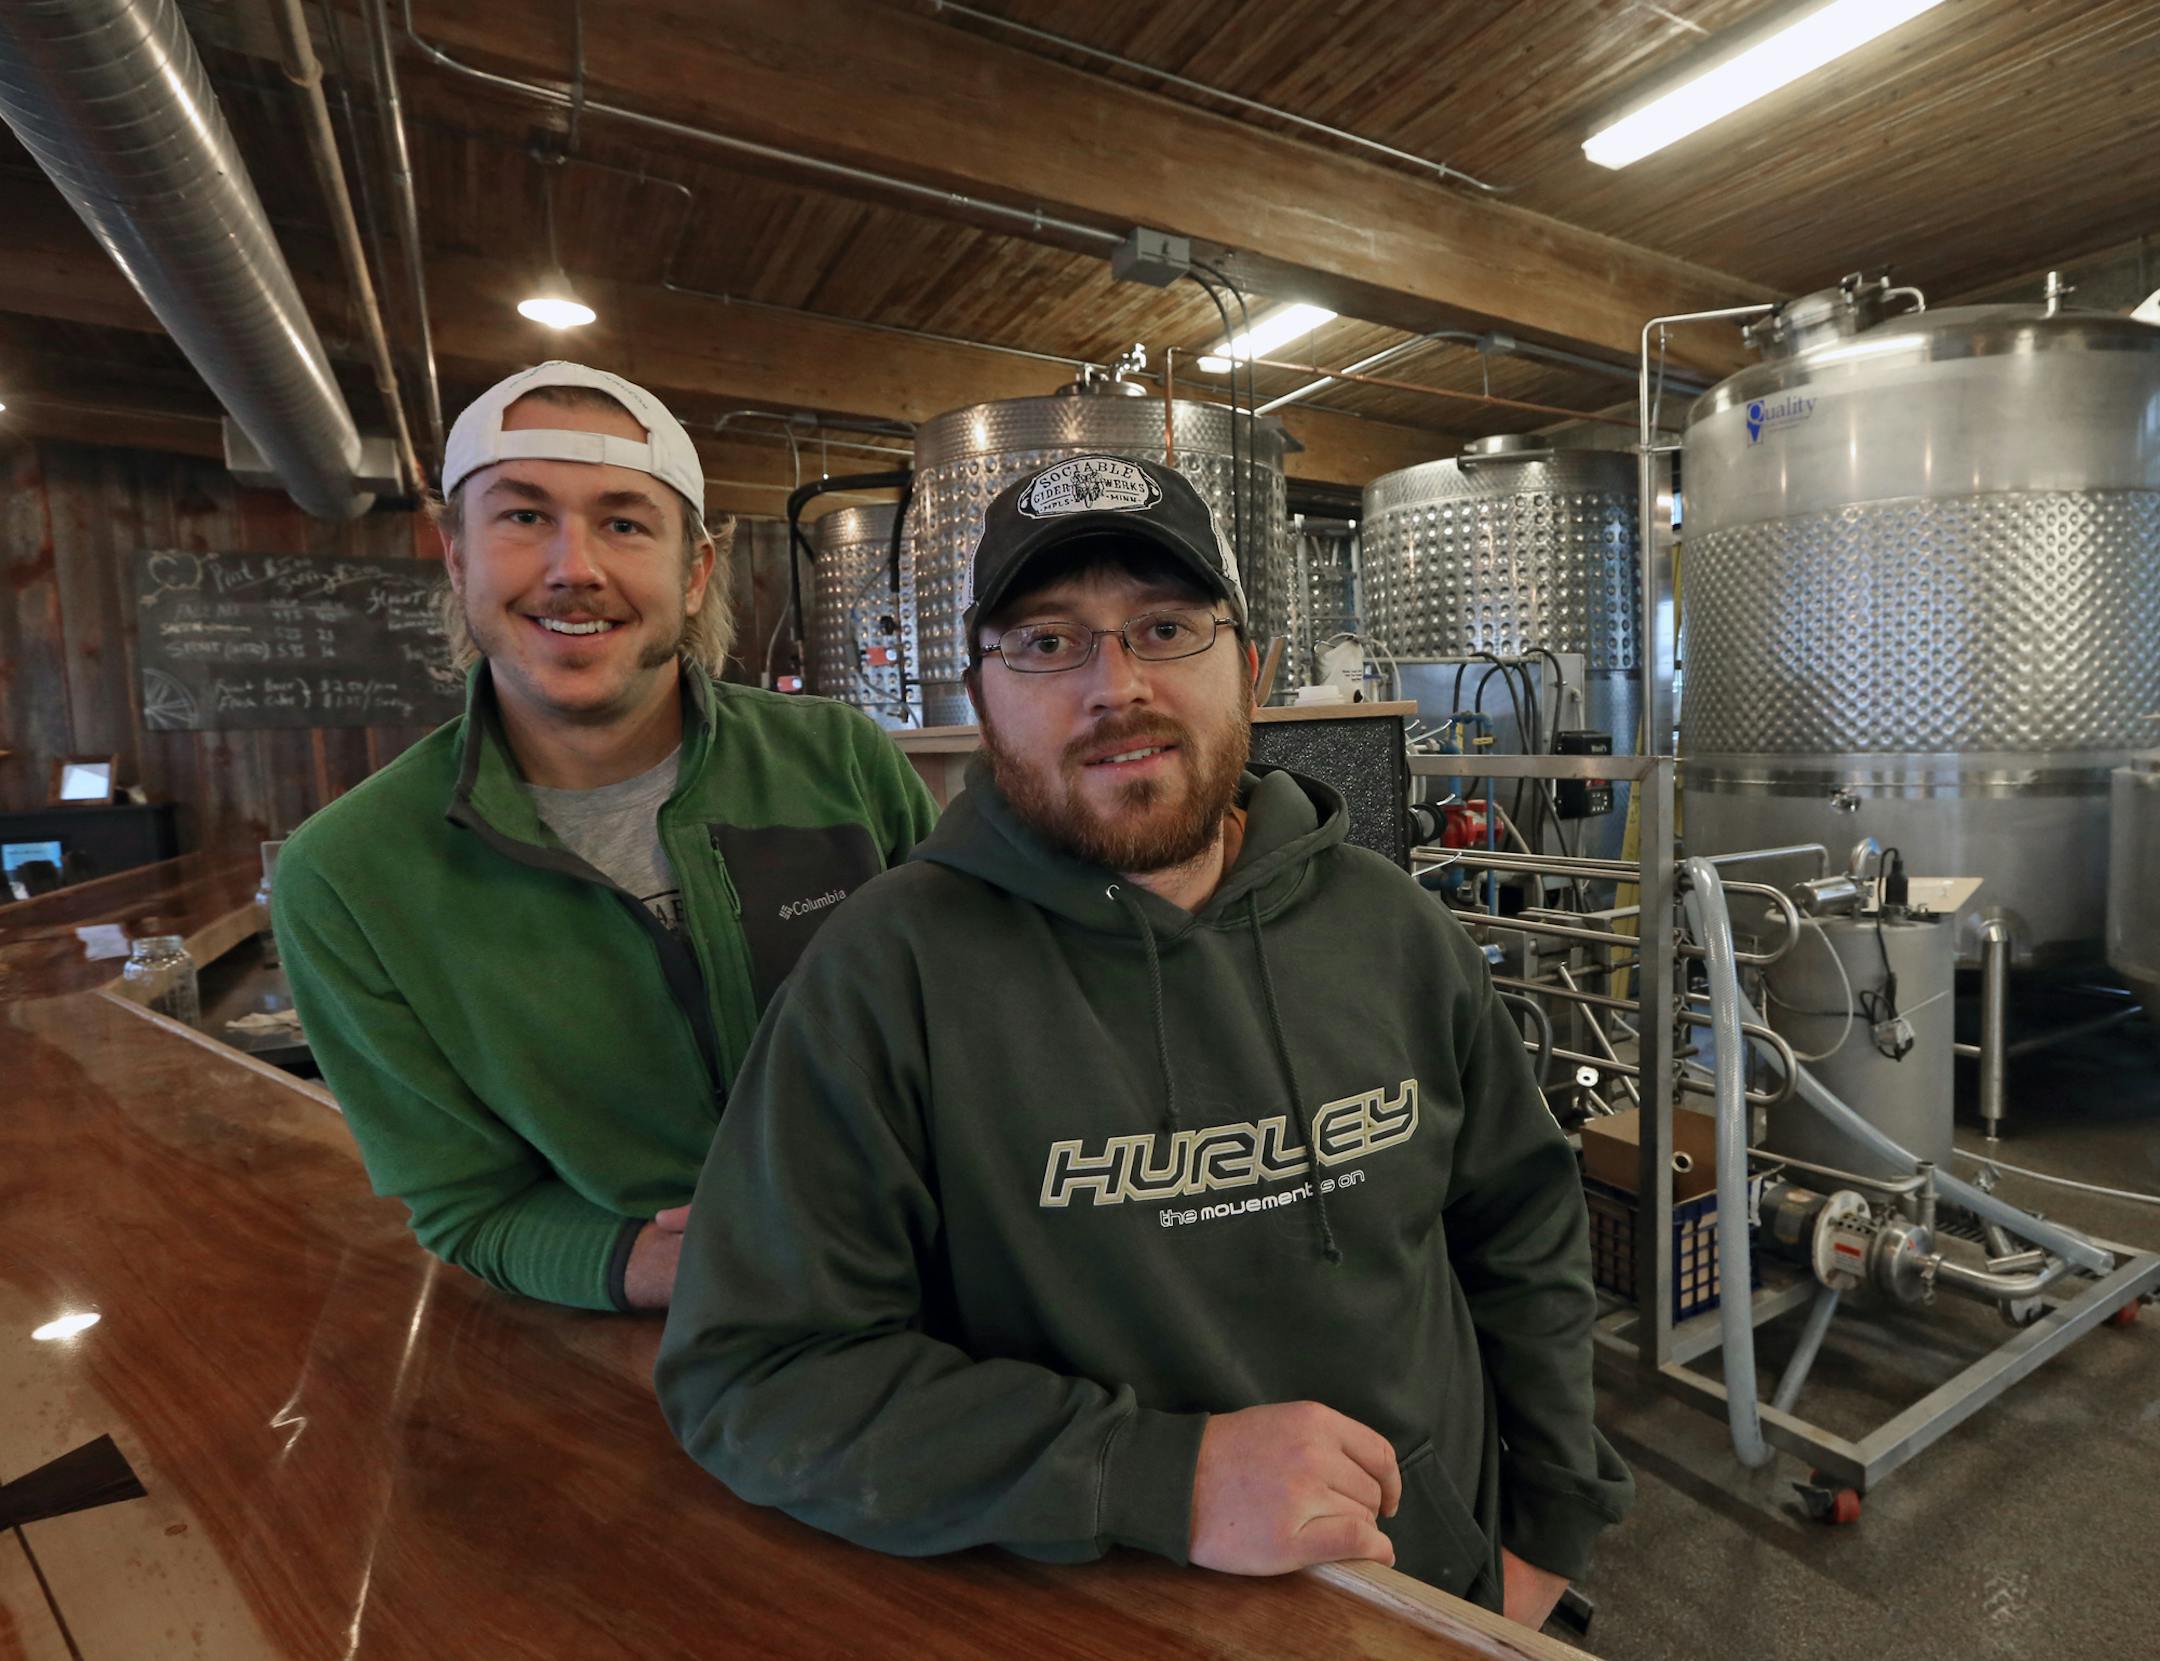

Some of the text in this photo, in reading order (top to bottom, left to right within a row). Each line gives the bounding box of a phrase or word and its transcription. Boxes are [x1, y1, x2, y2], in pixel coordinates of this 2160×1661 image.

[1747, 395, 1818, 422] Quality
[1039, 461, 1134, 489] SOCIABLE
[1033, 478, 1146, 504] CIDER WERKS
[791, 888, 847, 916] Columbia
[1039, 1078, 1419, 1207] HURLEY
[1159, 1207, 1198, 1228] the
[1201, 1182, 1314, 1222] movement
[1337, 1169, 1366, 1189] on
